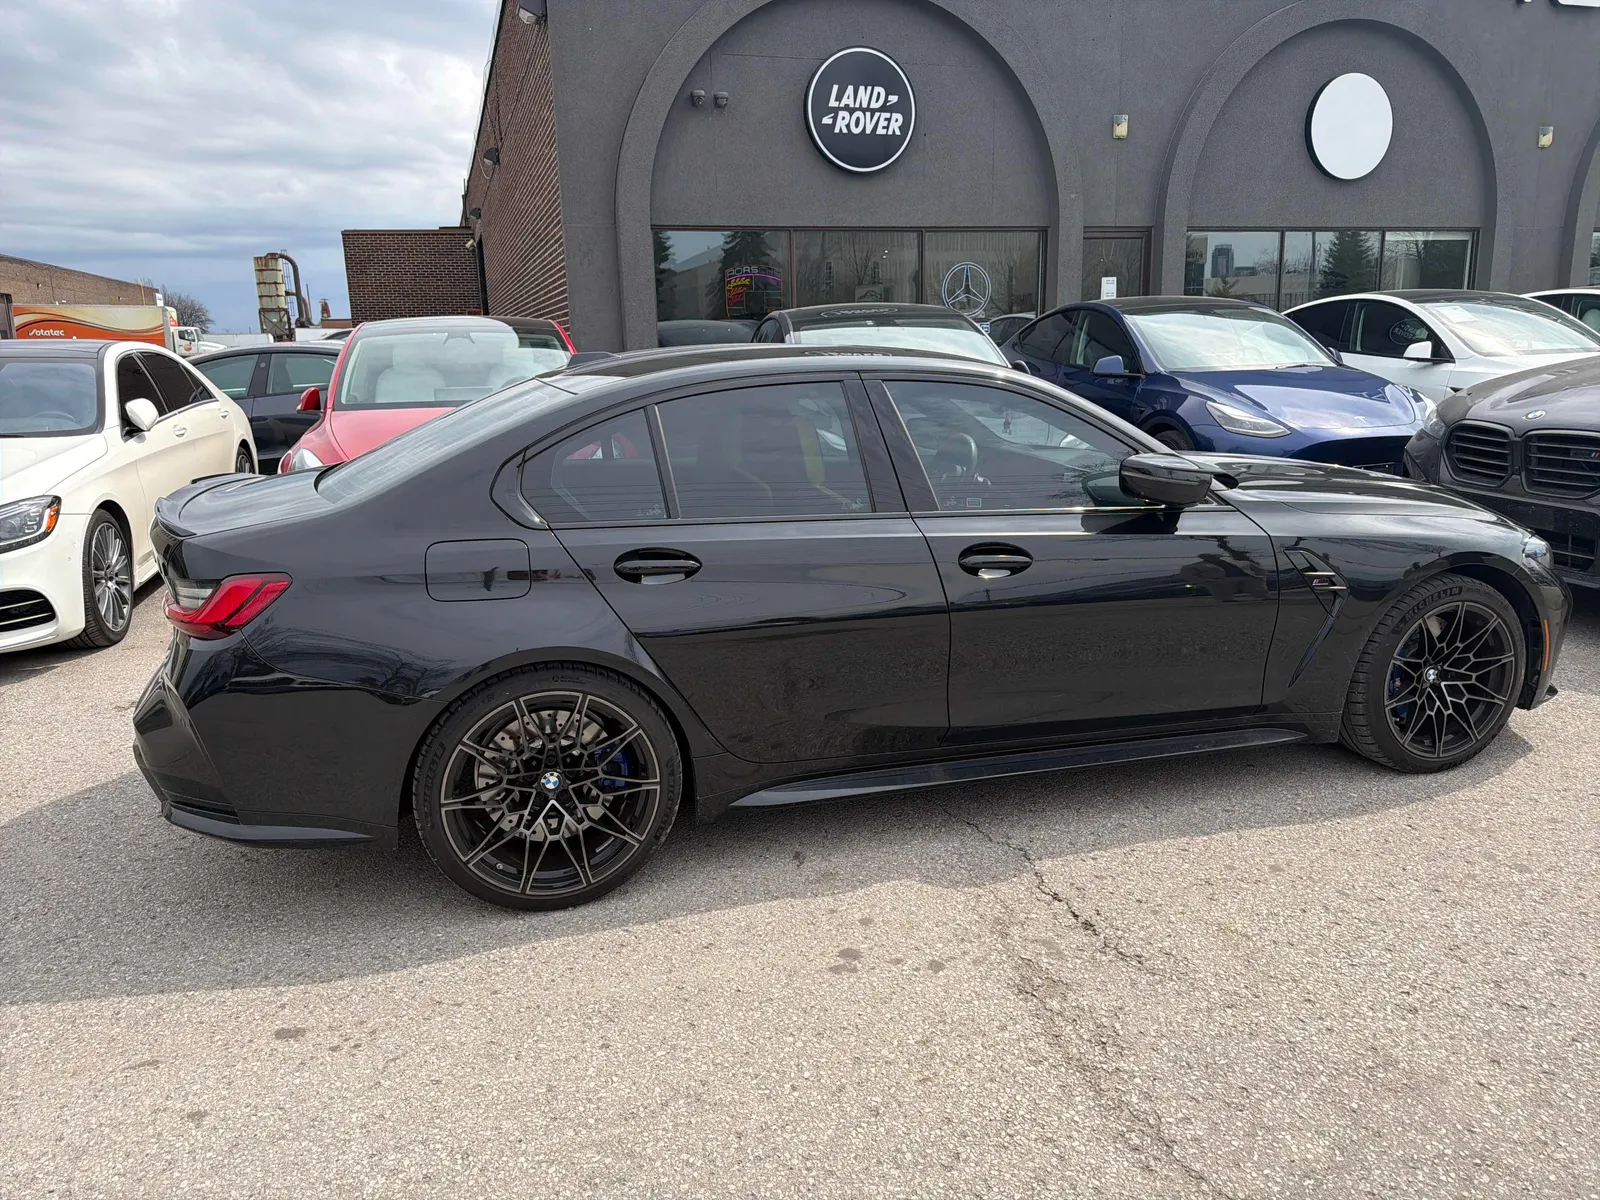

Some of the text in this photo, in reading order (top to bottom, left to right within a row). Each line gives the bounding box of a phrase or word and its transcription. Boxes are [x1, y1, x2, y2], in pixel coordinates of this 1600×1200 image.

[828, 84, 886, 109] LAND
[834, 111, 904, 135] ROVER
[1404, 586, 1462, 622] MICHELIN
